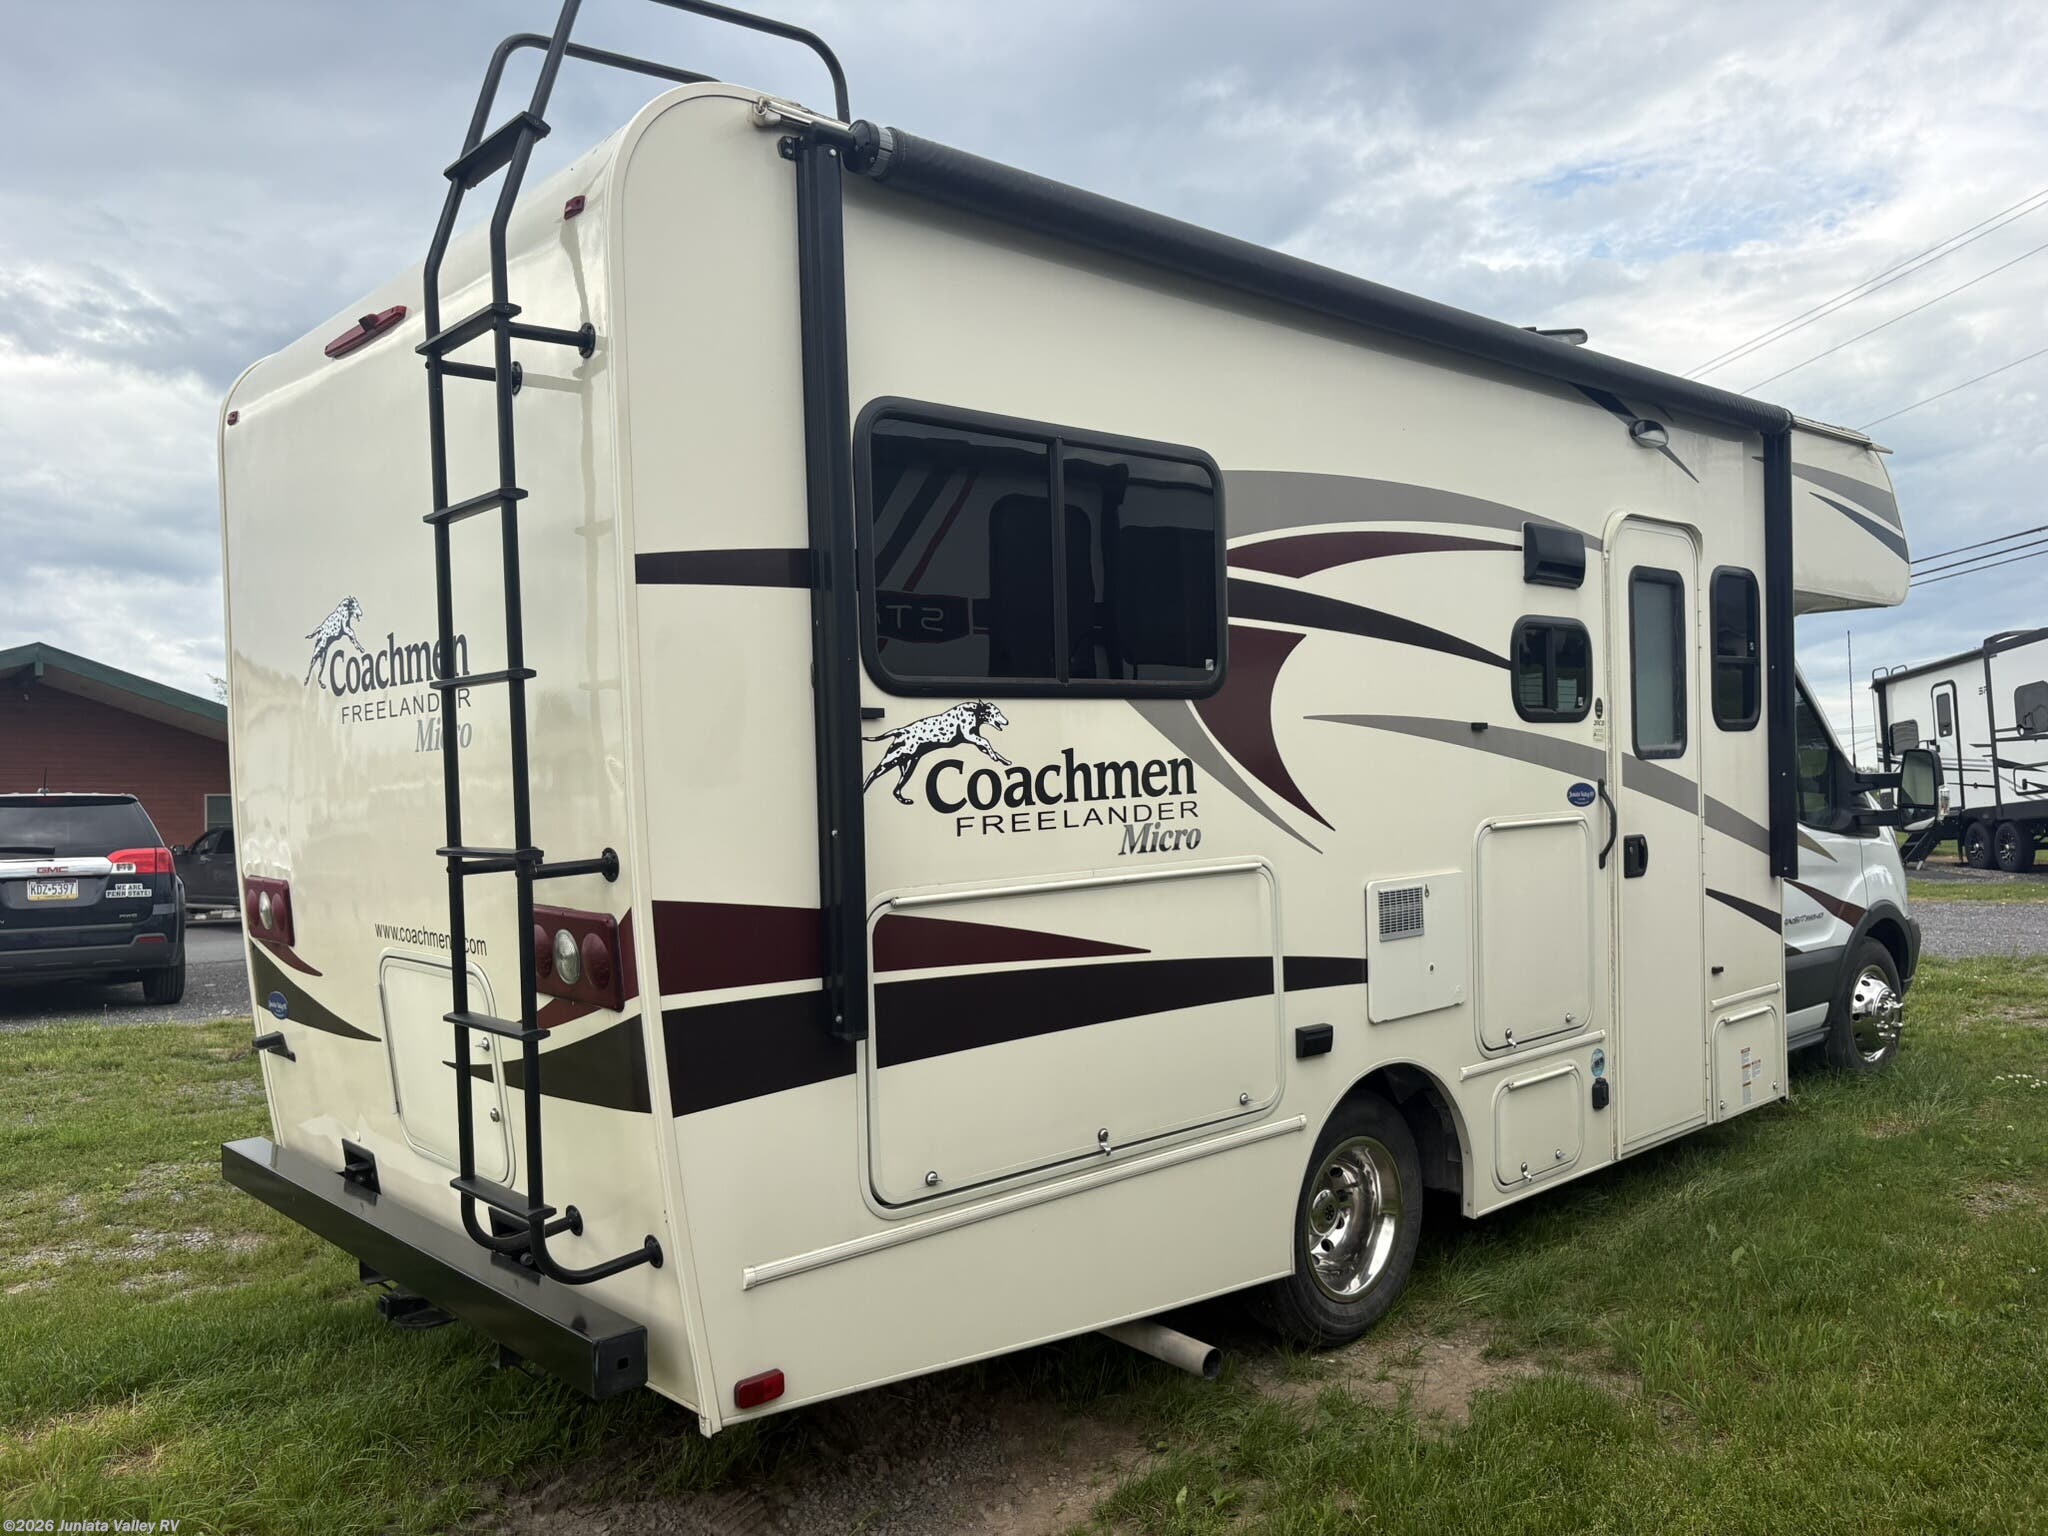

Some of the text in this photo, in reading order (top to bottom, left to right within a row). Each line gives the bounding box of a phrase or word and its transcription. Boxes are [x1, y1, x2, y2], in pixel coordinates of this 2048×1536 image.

[341, 687, 471, 725] FREELANDR
[414, 717, 473, 753] Mio
[925, 748, 1198, 814] Coachmen
[955, 800, 1199, 838] FREELANDER
[1117, 821, 1202, 856] Micro
[36, 866, 69, 874] GMC
